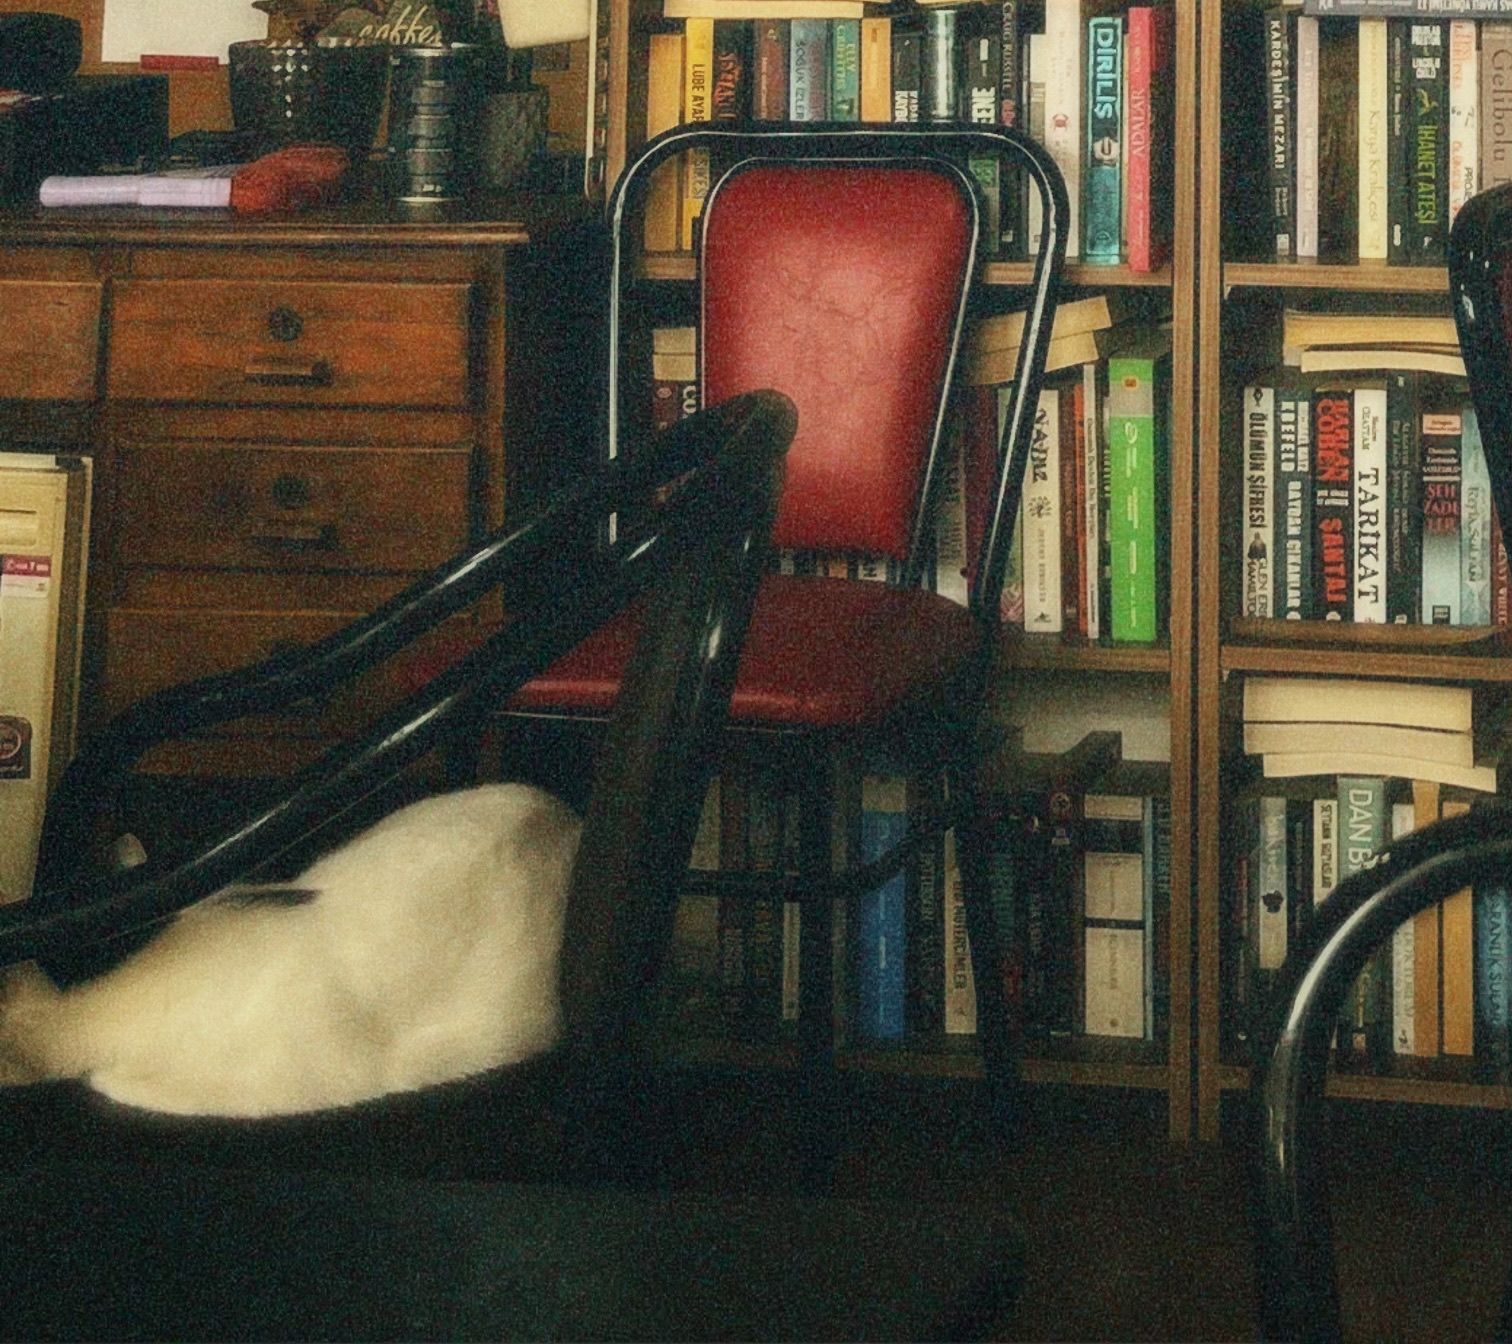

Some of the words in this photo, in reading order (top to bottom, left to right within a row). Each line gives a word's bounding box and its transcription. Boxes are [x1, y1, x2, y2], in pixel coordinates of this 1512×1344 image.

[1002, 0, 1016, 40] CRAIG
[1270, 20, 1289, 110] KARDEŞİMİN
[1272, 114, 1286, 169] MEZARI
[1416, 124, 1439, 178] İHANET
[1415, 181, 1439, 225] ATEŞİ
[1249, 412, 1269, 471] ÖLÜMÜN
[1248, 474, 1270, 529] ŞİFRESİ
[1319, 518, 1347, 602] ŞANTAJ
[1357, 467, 1381, 604] TARİKAT
[1348, 787, 1373, 839] DAN
